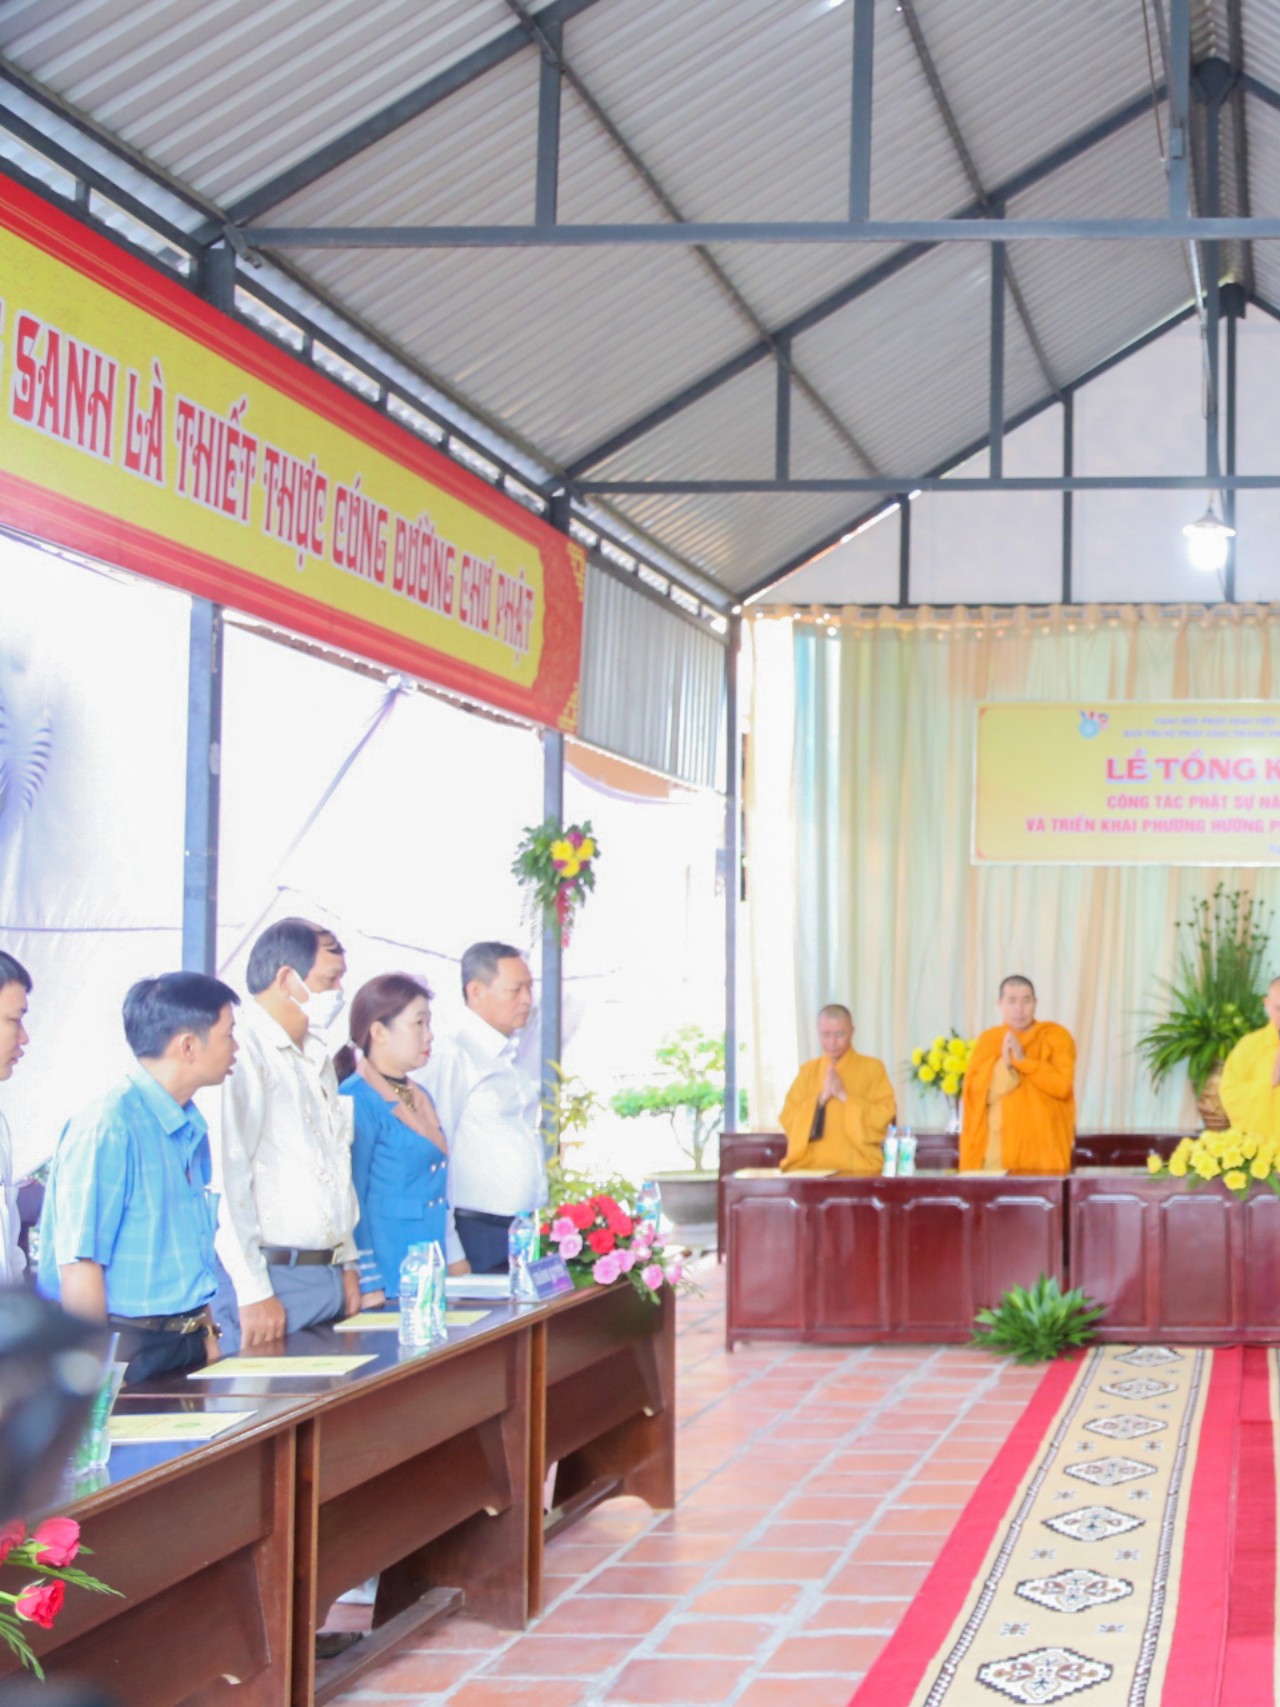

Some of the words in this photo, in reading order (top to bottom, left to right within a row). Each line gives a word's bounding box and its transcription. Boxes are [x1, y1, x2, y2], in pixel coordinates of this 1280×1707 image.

[13, 315, 117, 459] SANH
[124, 361, 164, 483] LÀ
[176, 398, 258, 522] THIẾT
[263, 446, 327, 568] THỰC
[332, 475, 389, 584] CÚNG
[458, 552, 494, 633] CHƯ
[494, 567, 534, 663] PHẬT
[1106, 794, 1149, 810] CÔNG
[1155, 794, 1184, 810] TÁC
[1189, 794, 1229, 813] PHẬT
[1233, 795, 1256, 813] SỰ
[1026, 816, 1046, 832] VÀ
[1051, 814, 1096, 833] TRIỂN
[1101, 818, 1137, 833] KHAI
